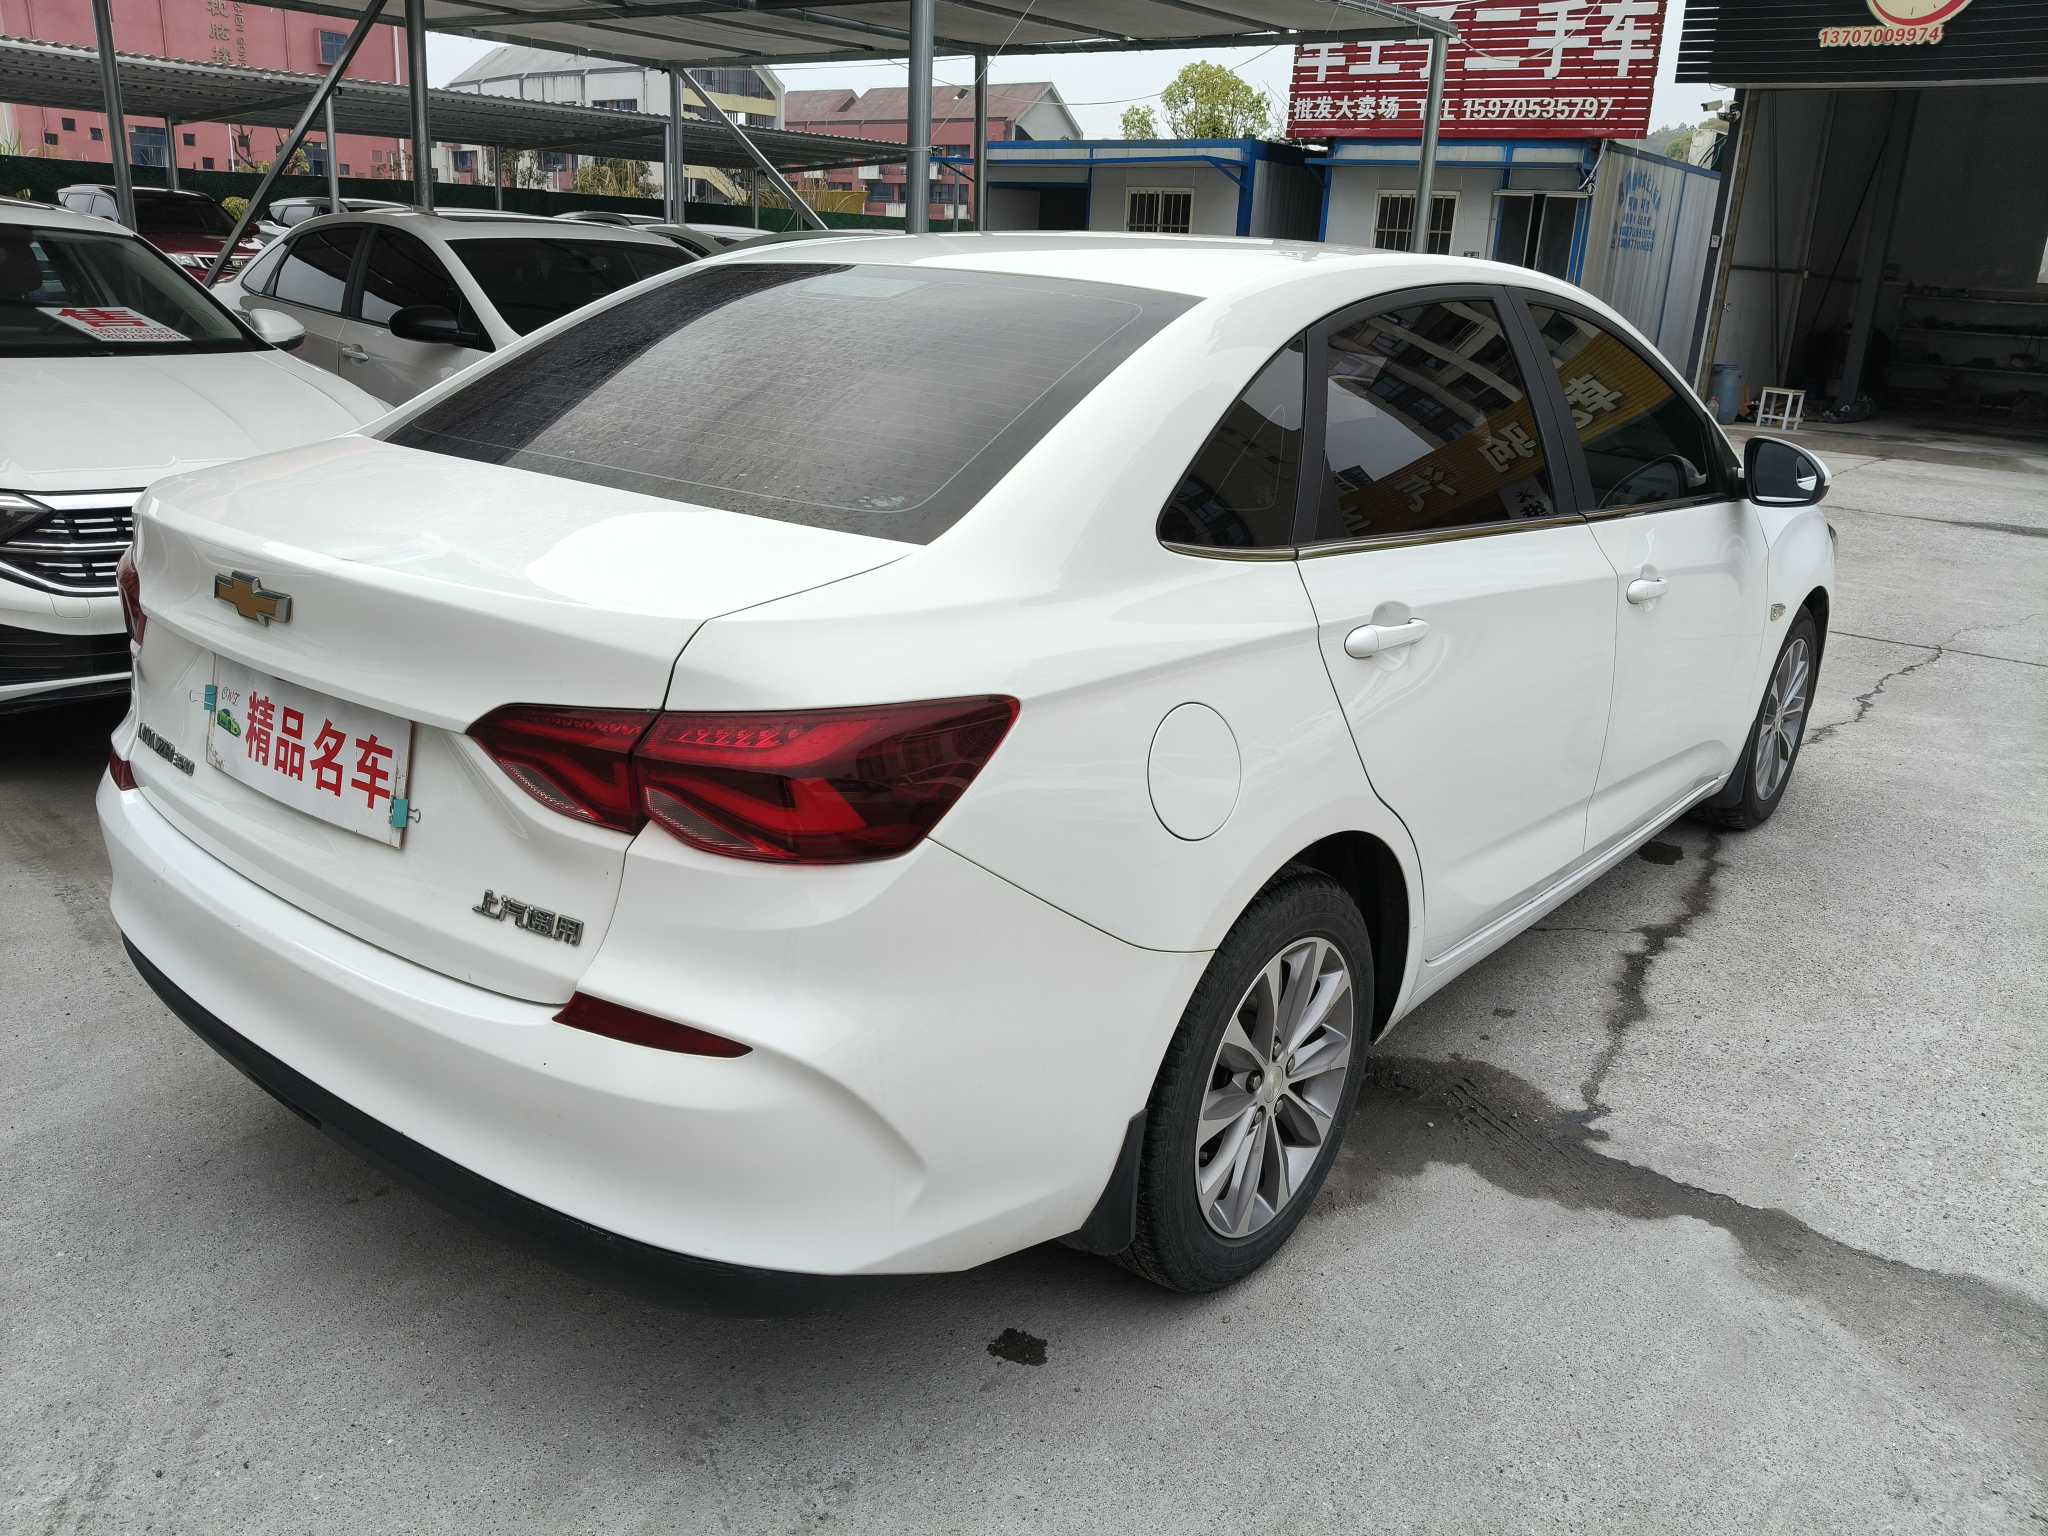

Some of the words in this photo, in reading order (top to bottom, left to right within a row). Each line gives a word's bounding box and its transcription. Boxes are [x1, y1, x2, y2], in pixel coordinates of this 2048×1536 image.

[1820, 27, 1943, 45] 13707009974
[1293, 95, 1400, 120] 批发大卖场
[1463, 97, 1613, 120] 15970535797
[245, 690, 394, 810] 精品名车
[471, 888, 585, 947] 上汽通用
